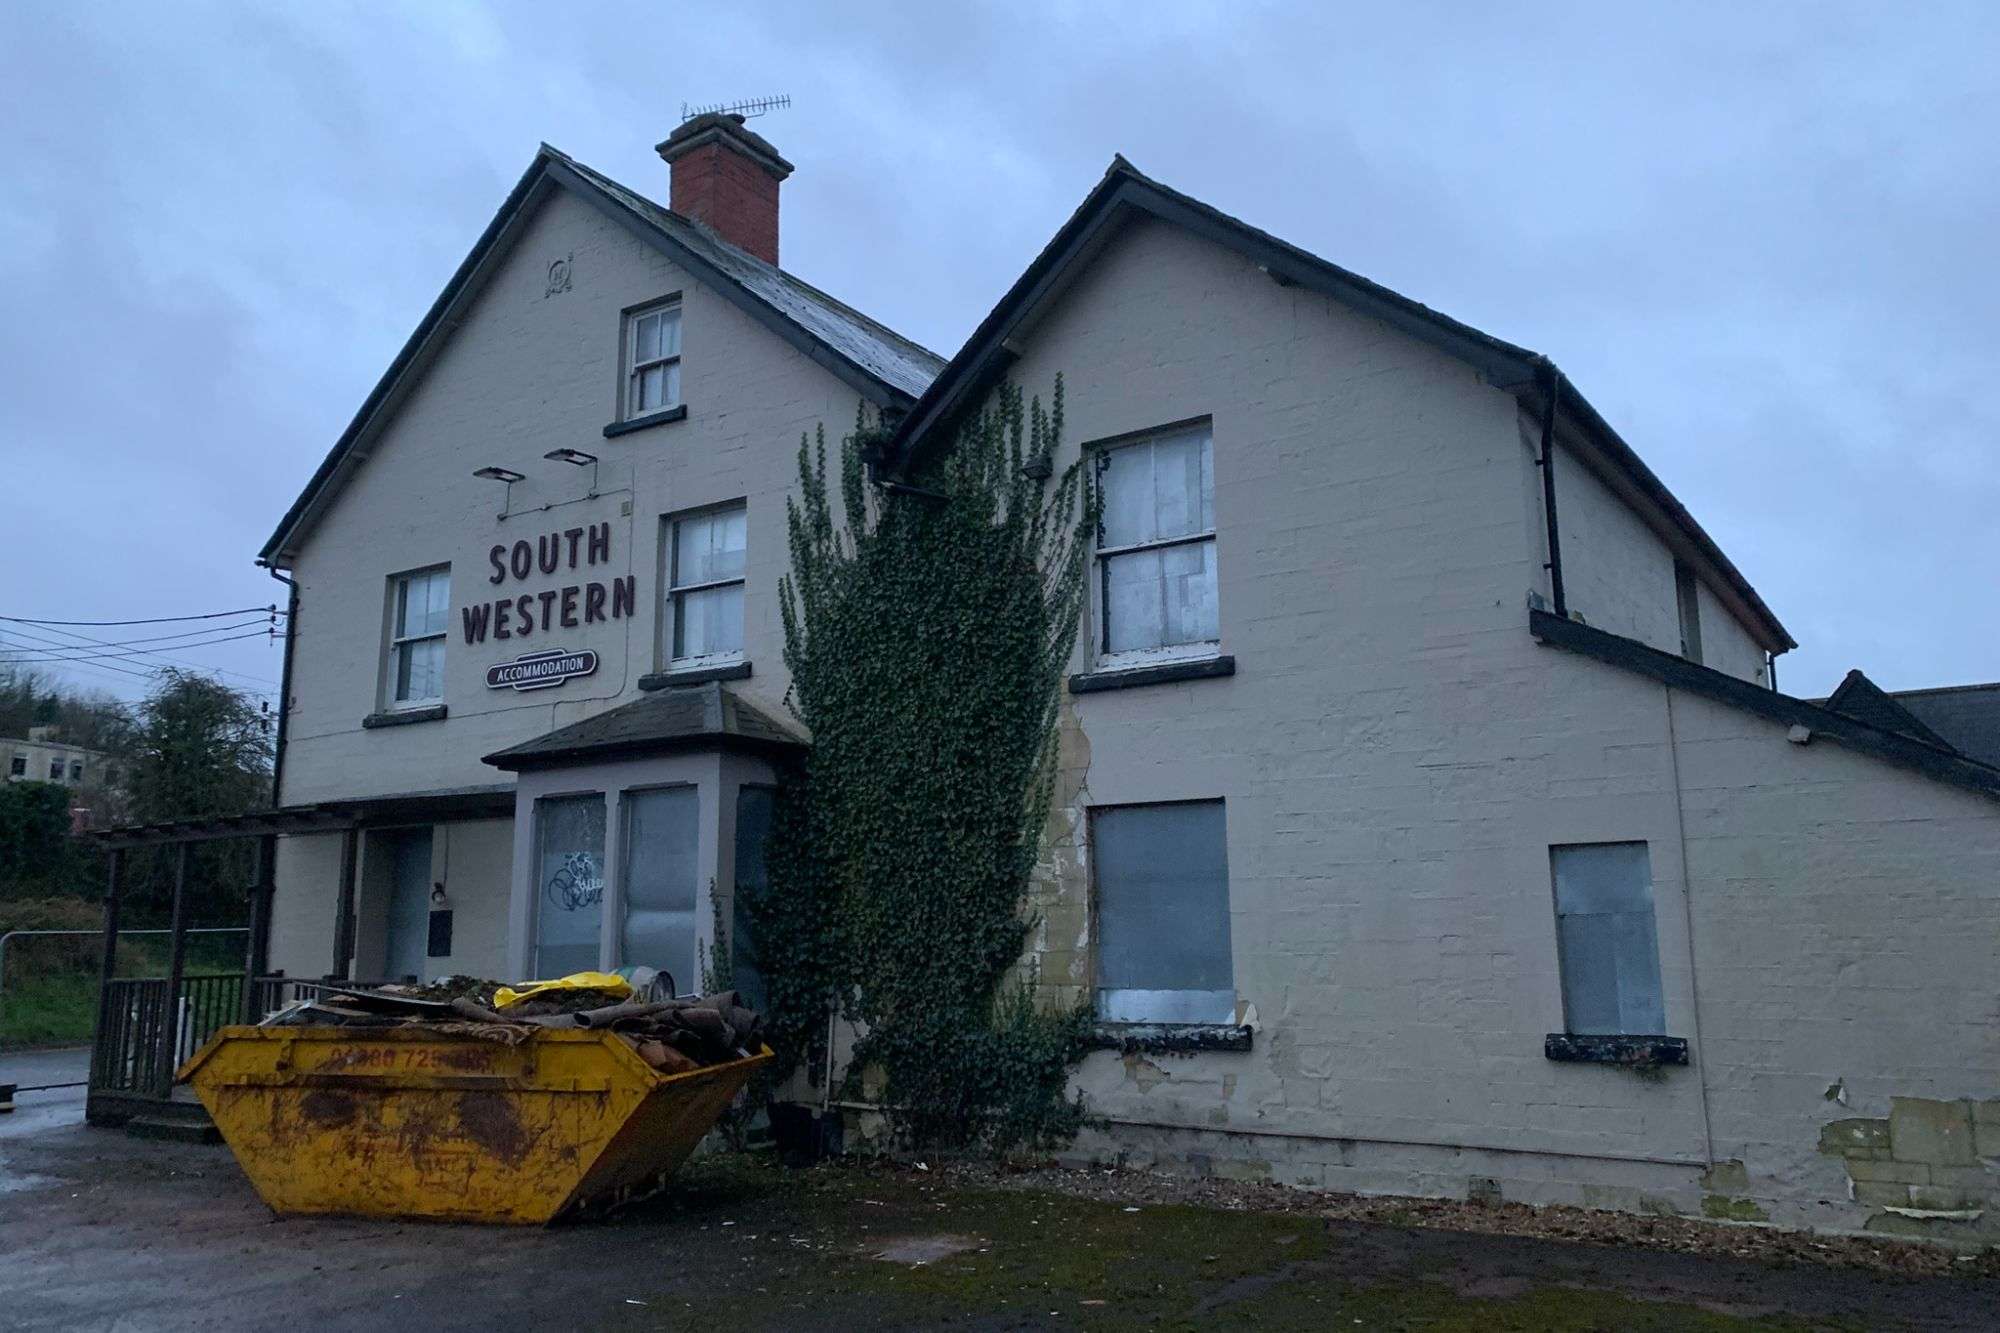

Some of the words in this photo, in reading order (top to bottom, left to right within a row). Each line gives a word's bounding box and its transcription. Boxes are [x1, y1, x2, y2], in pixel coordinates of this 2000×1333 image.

[489, 522, 610, 585] SOUTH
[462, 575, 635, 645] WESTERN
[497, 657, 584, 682] ACCOMMODATION
